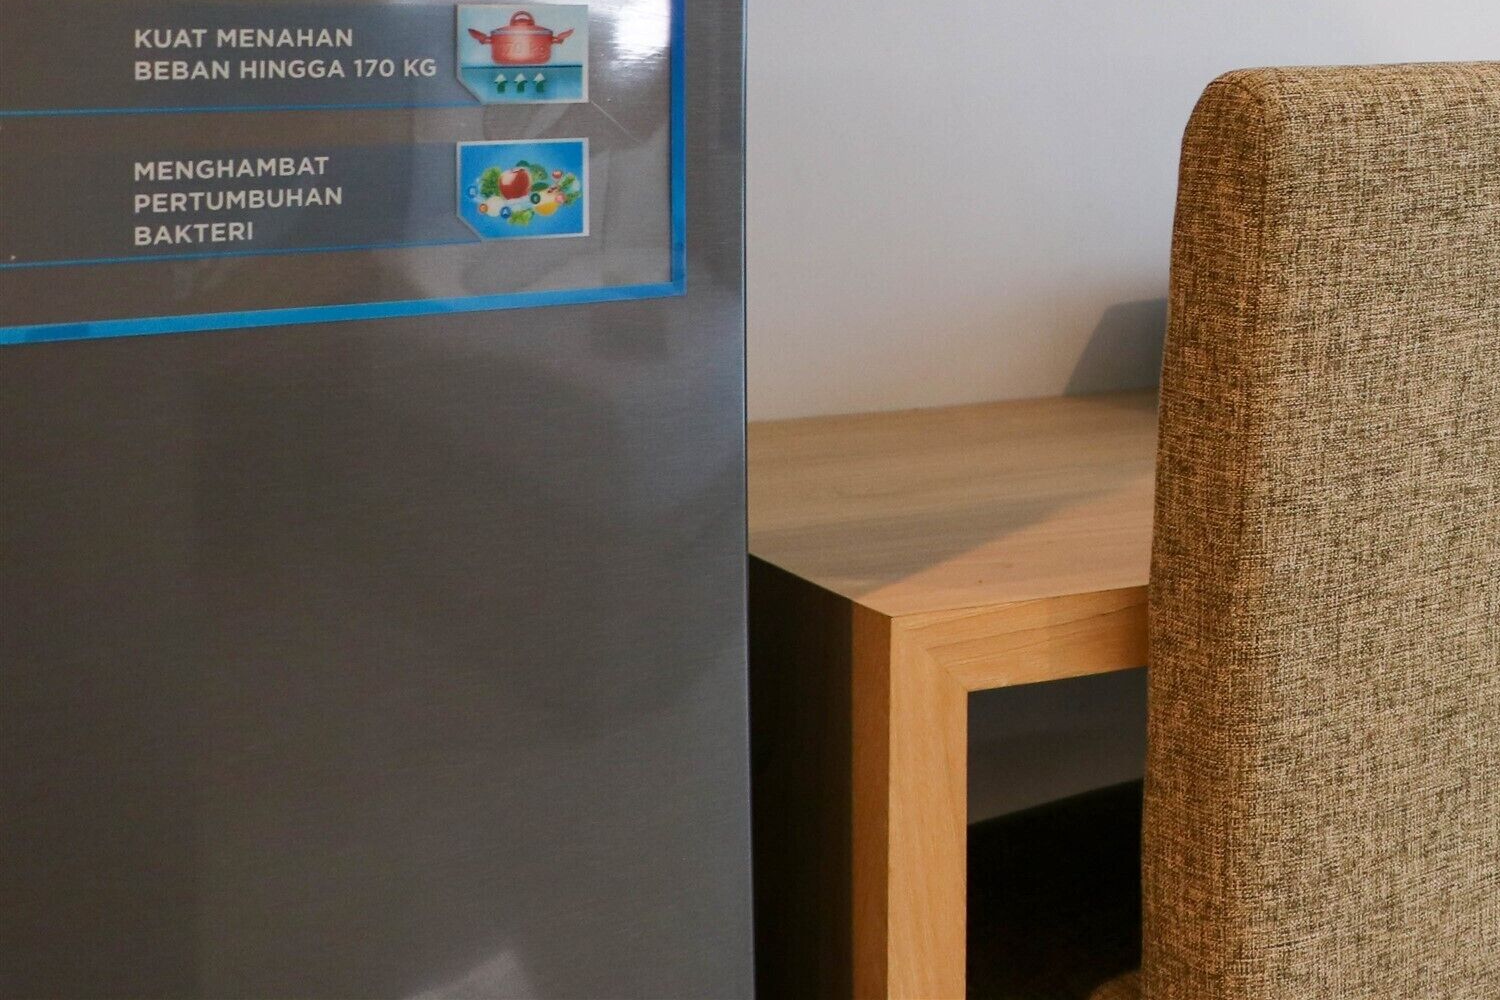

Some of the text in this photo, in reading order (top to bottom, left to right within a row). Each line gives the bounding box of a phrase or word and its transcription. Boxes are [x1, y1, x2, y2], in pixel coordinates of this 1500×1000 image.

[134, 28, 353, 49] KUAT MENAHAN
[134, 58, 437, 81] BEBAN HINGGA 170 KG
[134, 156, 329, 181] MENGHAMBAT
[134, 186, 343, 213] PERTUMBUHAN
[134, 221, 253, 246] BAKTERI
